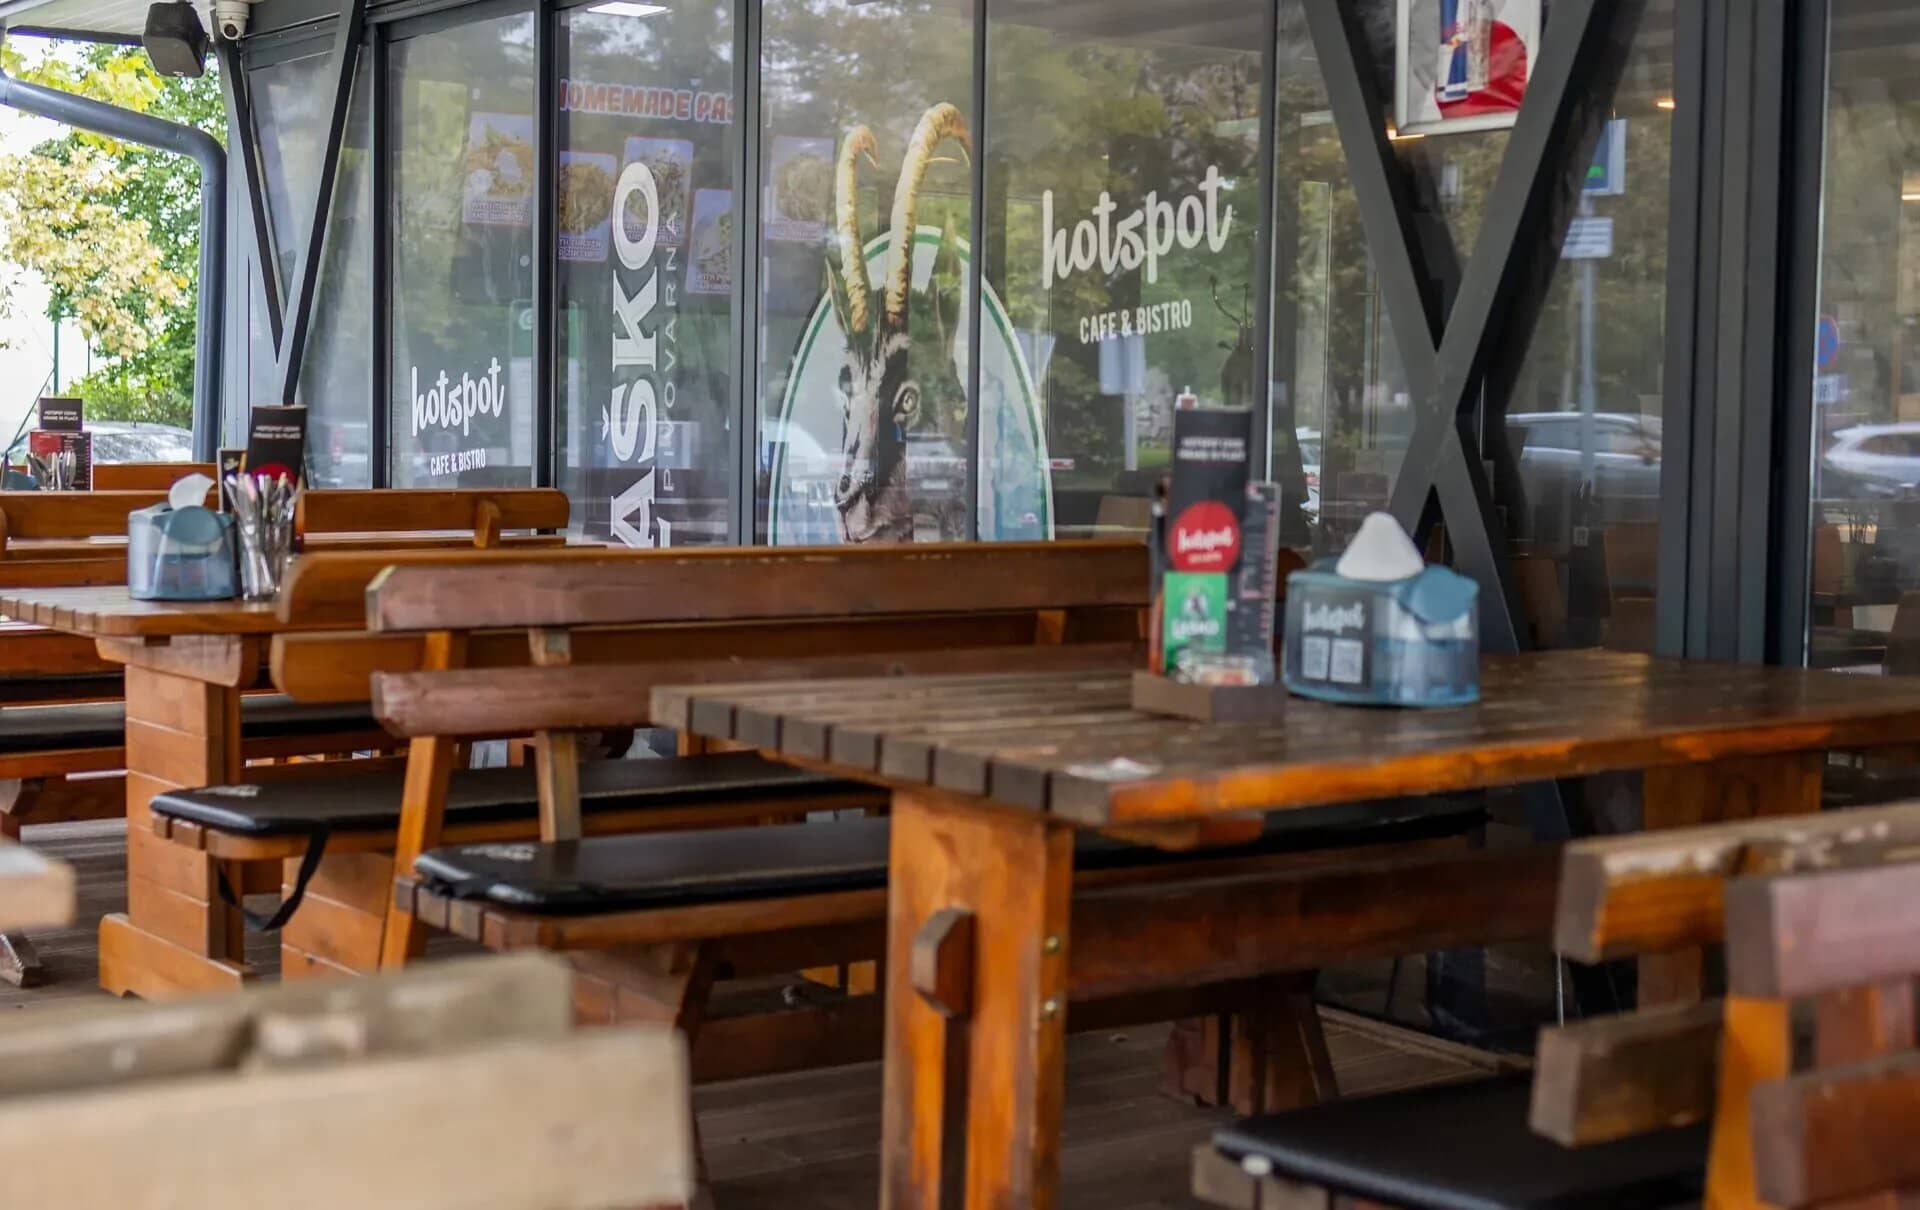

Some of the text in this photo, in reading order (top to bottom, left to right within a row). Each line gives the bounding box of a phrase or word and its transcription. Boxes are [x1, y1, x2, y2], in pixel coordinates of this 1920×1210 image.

[1043, 165, 1232, 290] hotspot
[602, 162, 671, 548] AŠKO
[664, 210, 678, 491] PIVOVARNA
[1080, 299, 1192, 344] CAFE & BISTRO
[411, 357, 504, 437] hotspot
[430, 448, 486, 477] CAFE & BISTRO
